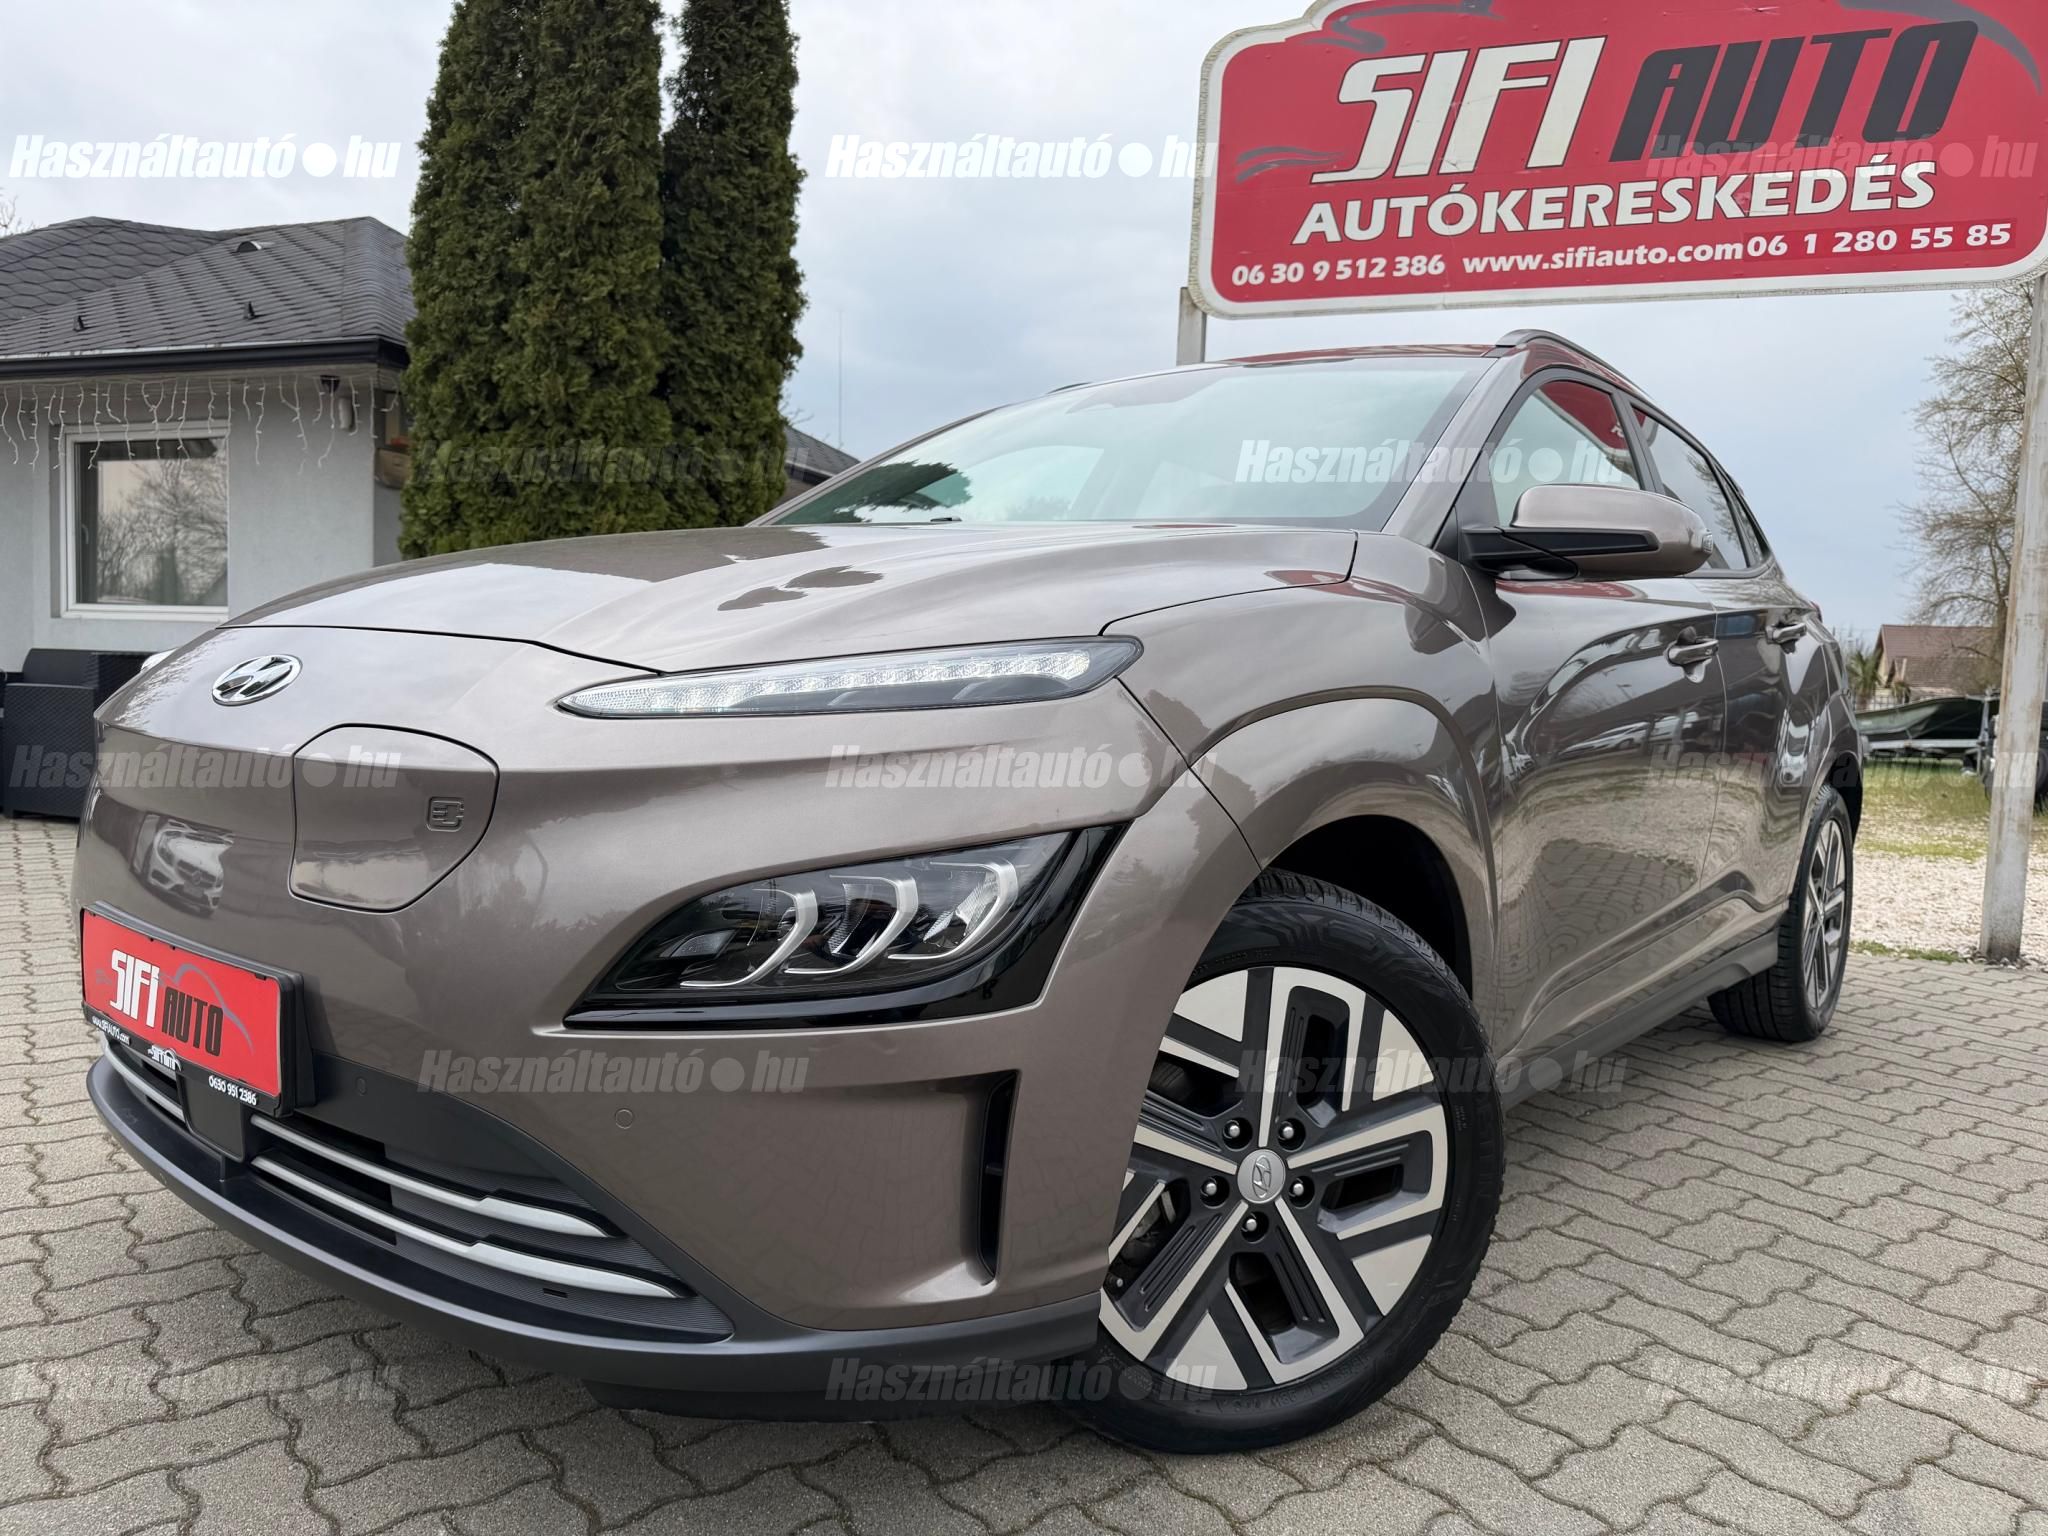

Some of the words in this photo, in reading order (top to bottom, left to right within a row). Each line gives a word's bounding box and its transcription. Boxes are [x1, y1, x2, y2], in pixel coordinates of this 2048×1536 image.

[1310, 34, 1607, 185] SIFI
[1608, 20, 1979, 163] AUTO
[1290, 154, 1936, 246] AUTÓKERESKEDÉS
[1747, 234, 1787, 257] 06
[1804, 233, 1817, 254] 1
[1832, 229, 1897, 253] 280
[1910, 226, 1954, 249] 55
[1966, 222, 2011, 247] 85
[1231, 264, 1265, 286] 06
[1270, 261, 1304, 284] 30
[1312, 261, 1330, 282] 9
[1335, 257, 1386, 281] 512
[1392, 254, 1445, 277] 386
[1462, 241, 1743, 274] www.sifiauto.com
[162, 986, 224, 1057] AUTO
[208, 1075, 226, 1093] 0630
[227, 1083, 238, 1098] 951
[239, 1088, 257, 1105] 2386
